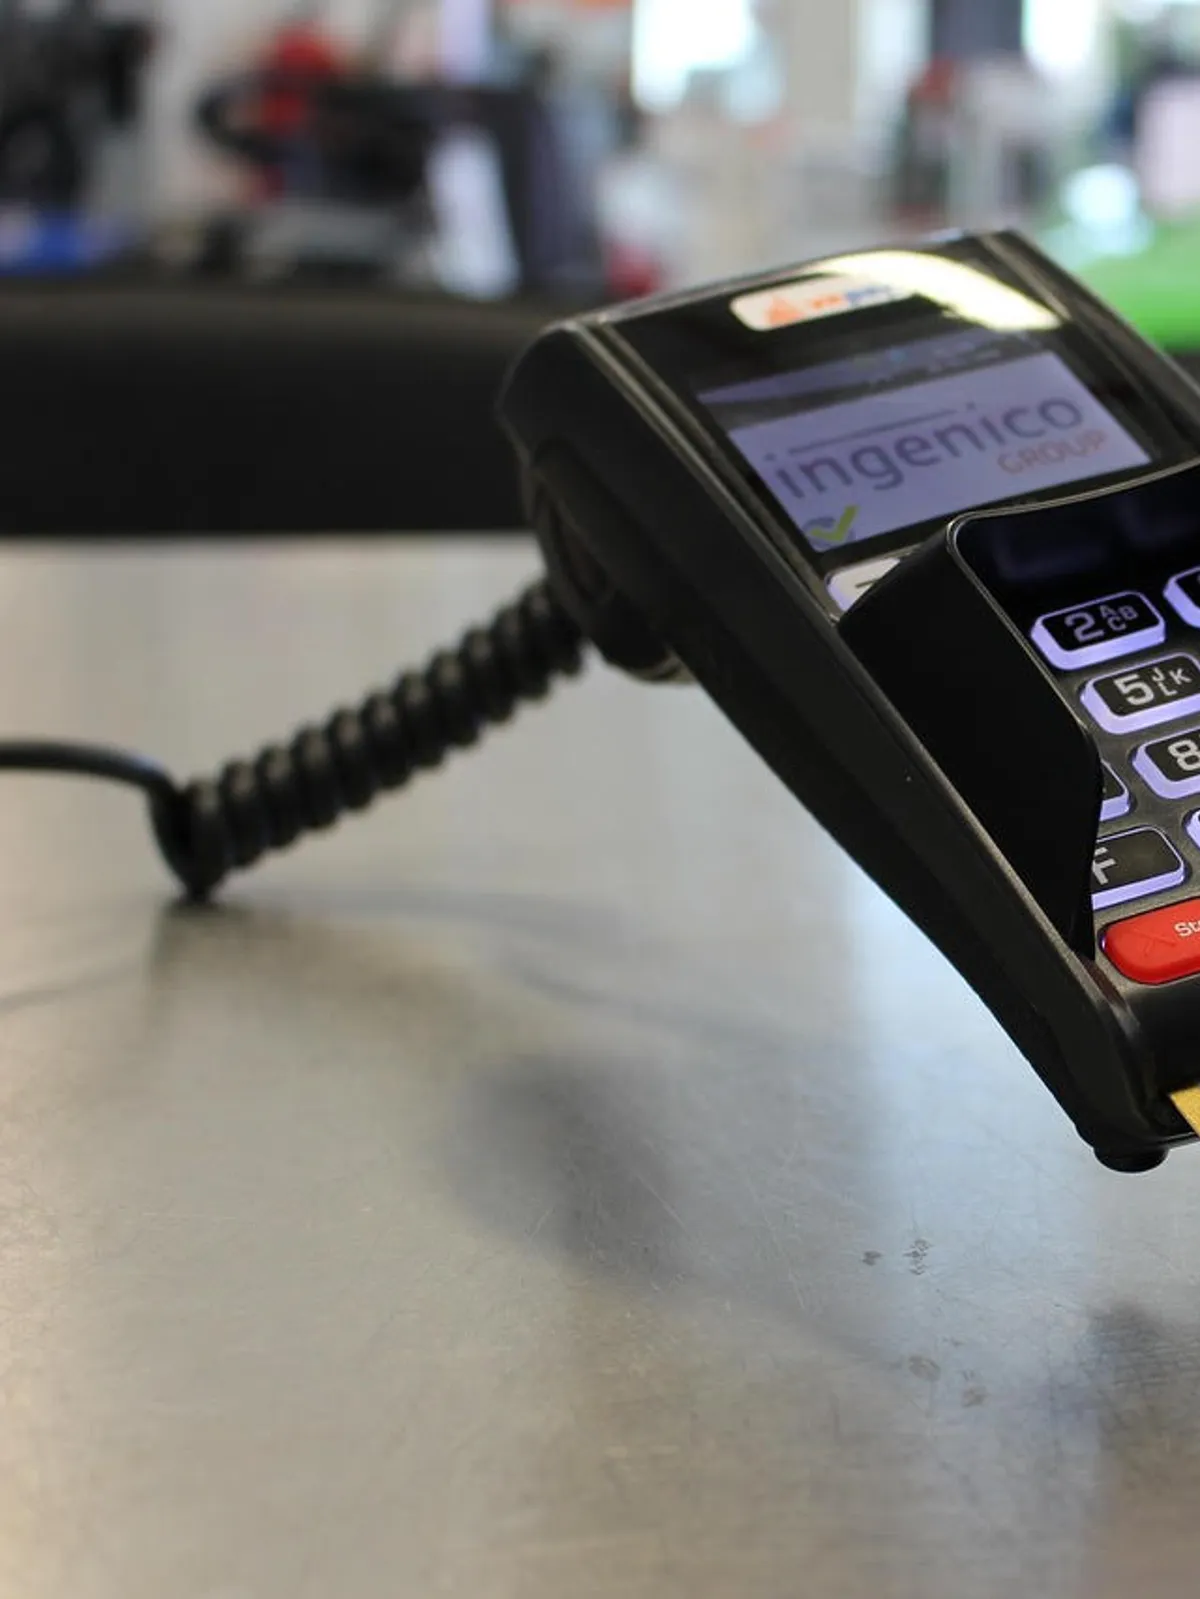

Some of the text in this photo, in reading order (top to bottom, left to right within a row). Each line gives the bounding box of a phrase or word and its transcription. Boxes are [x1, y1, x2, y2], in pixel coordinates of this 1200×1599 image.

[765, 397, 1083, 498] ingenico
[998, 428, 1109, 475] GROUP
[1064, 611, 1105, 643] 2
[1113, 673, 1155, 706] 5
